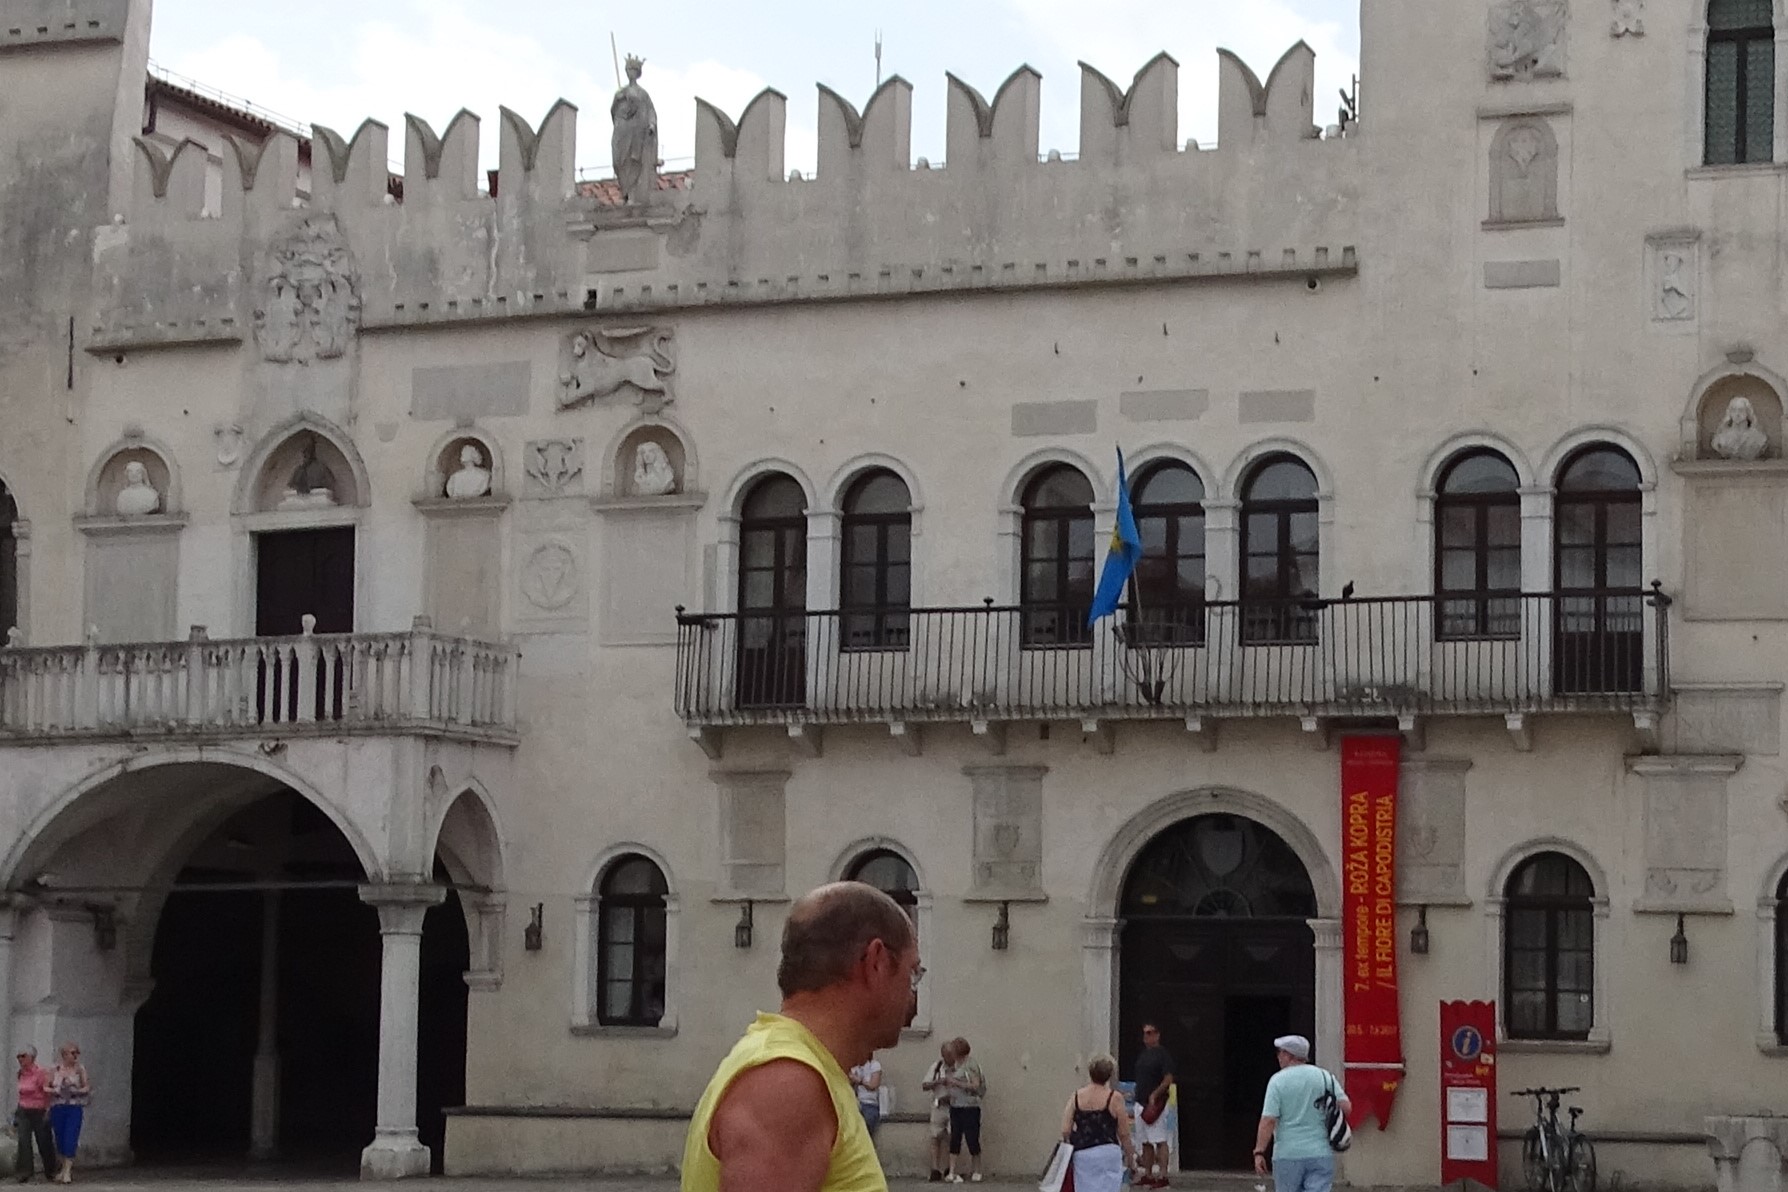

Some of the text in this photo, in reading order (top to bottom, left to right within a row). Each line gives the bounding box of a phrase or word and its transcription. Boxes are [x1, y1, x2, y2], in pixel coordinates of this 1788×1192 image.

[1350, 791, 1369, 847] KOPRA
[1376, 795, 1393, 895] CAPODISTRIA
[1346, 851, 1369, 894] ROŽA
[1376, 899, 1392, 914] DI
[1355, 906, 1372, 960] tempore
[1376, 917, 1392, 962] FIORE
[1376, 964, 1393, 977] IL
